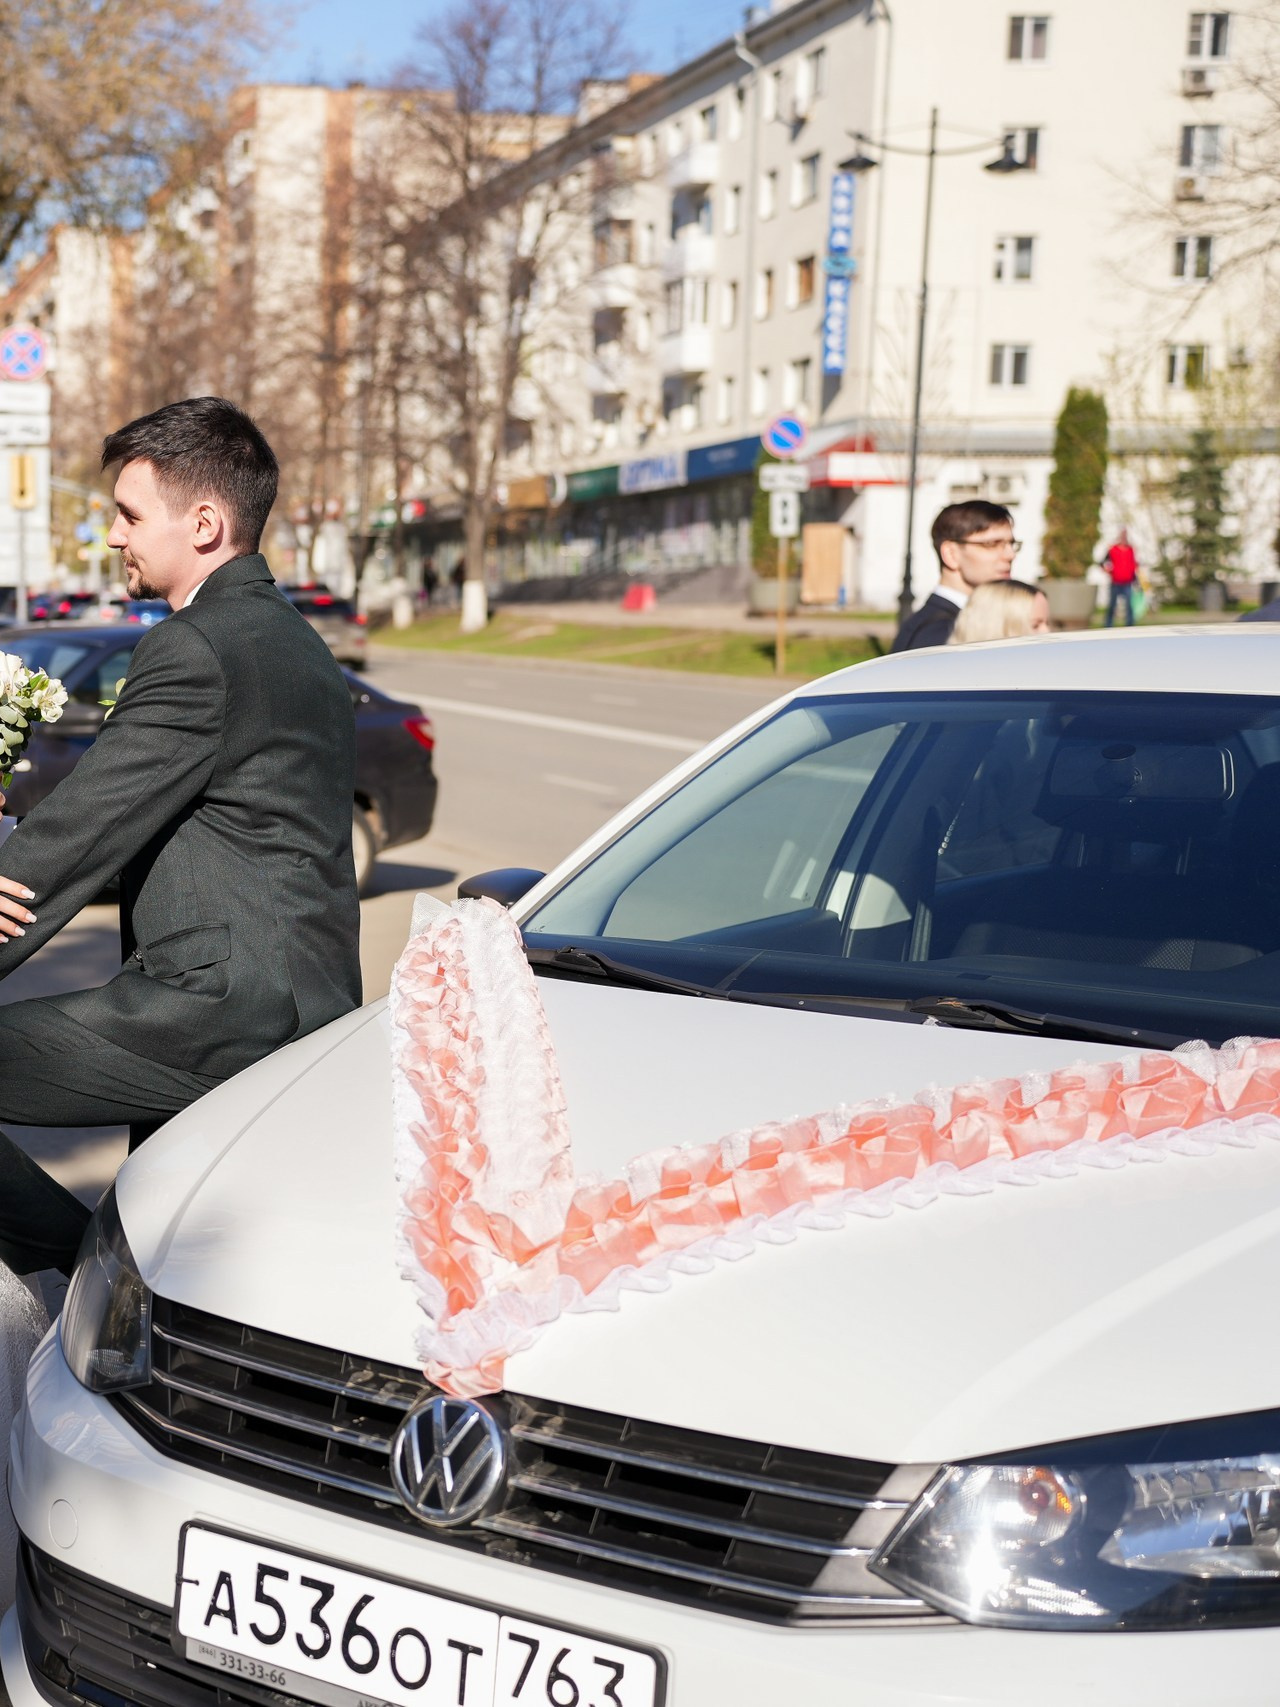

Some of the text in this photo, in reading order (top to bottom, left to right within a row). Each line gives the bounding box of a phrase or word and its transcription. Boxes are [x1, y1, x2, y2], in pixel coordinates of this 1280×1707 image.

[203, 1562, 626, 1707] А536ОТ 763
[220, 1652, 287, 1686] 331-33-66
